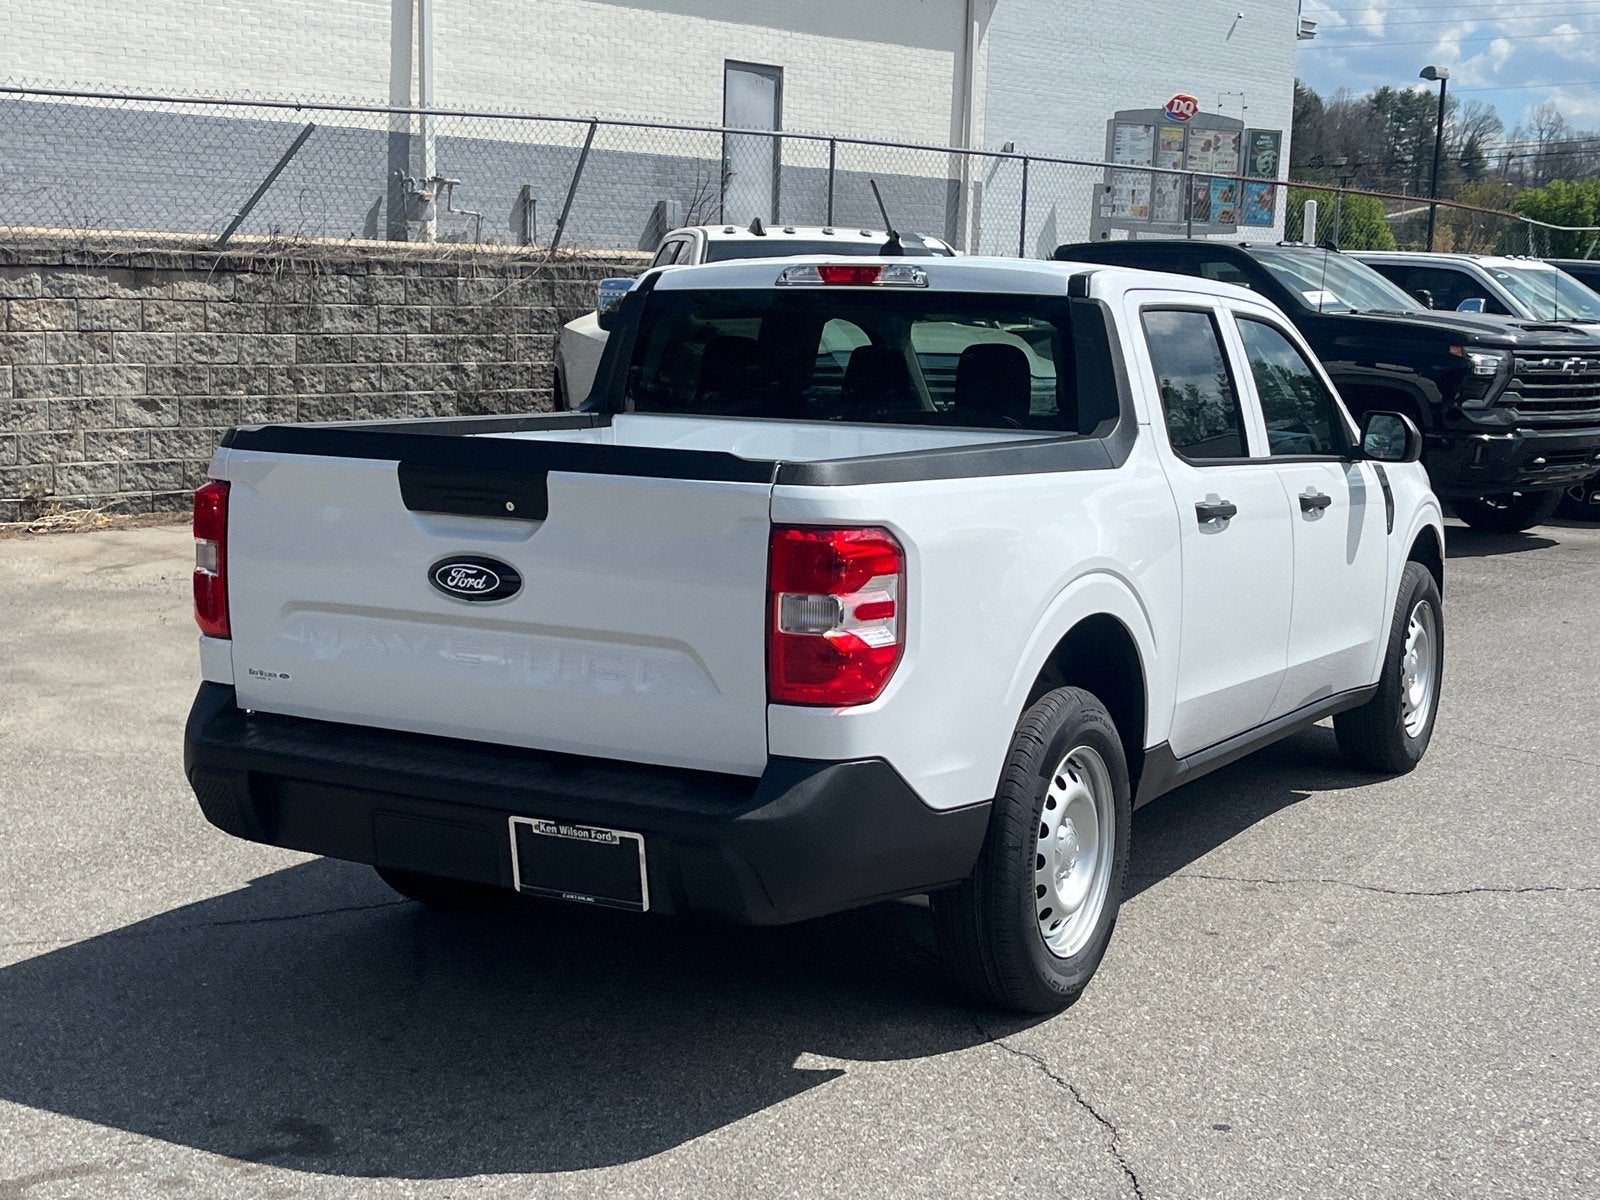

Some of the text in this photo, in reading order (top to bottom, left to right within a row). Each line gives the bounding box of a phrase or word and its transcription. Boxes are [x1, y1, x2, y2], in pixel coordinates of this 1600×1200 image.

[1171, 99, 1195, 116] DQ
[447, 567, 487, 589] Ford
[539, 822, 612, 841] Ken Wilson Ford
